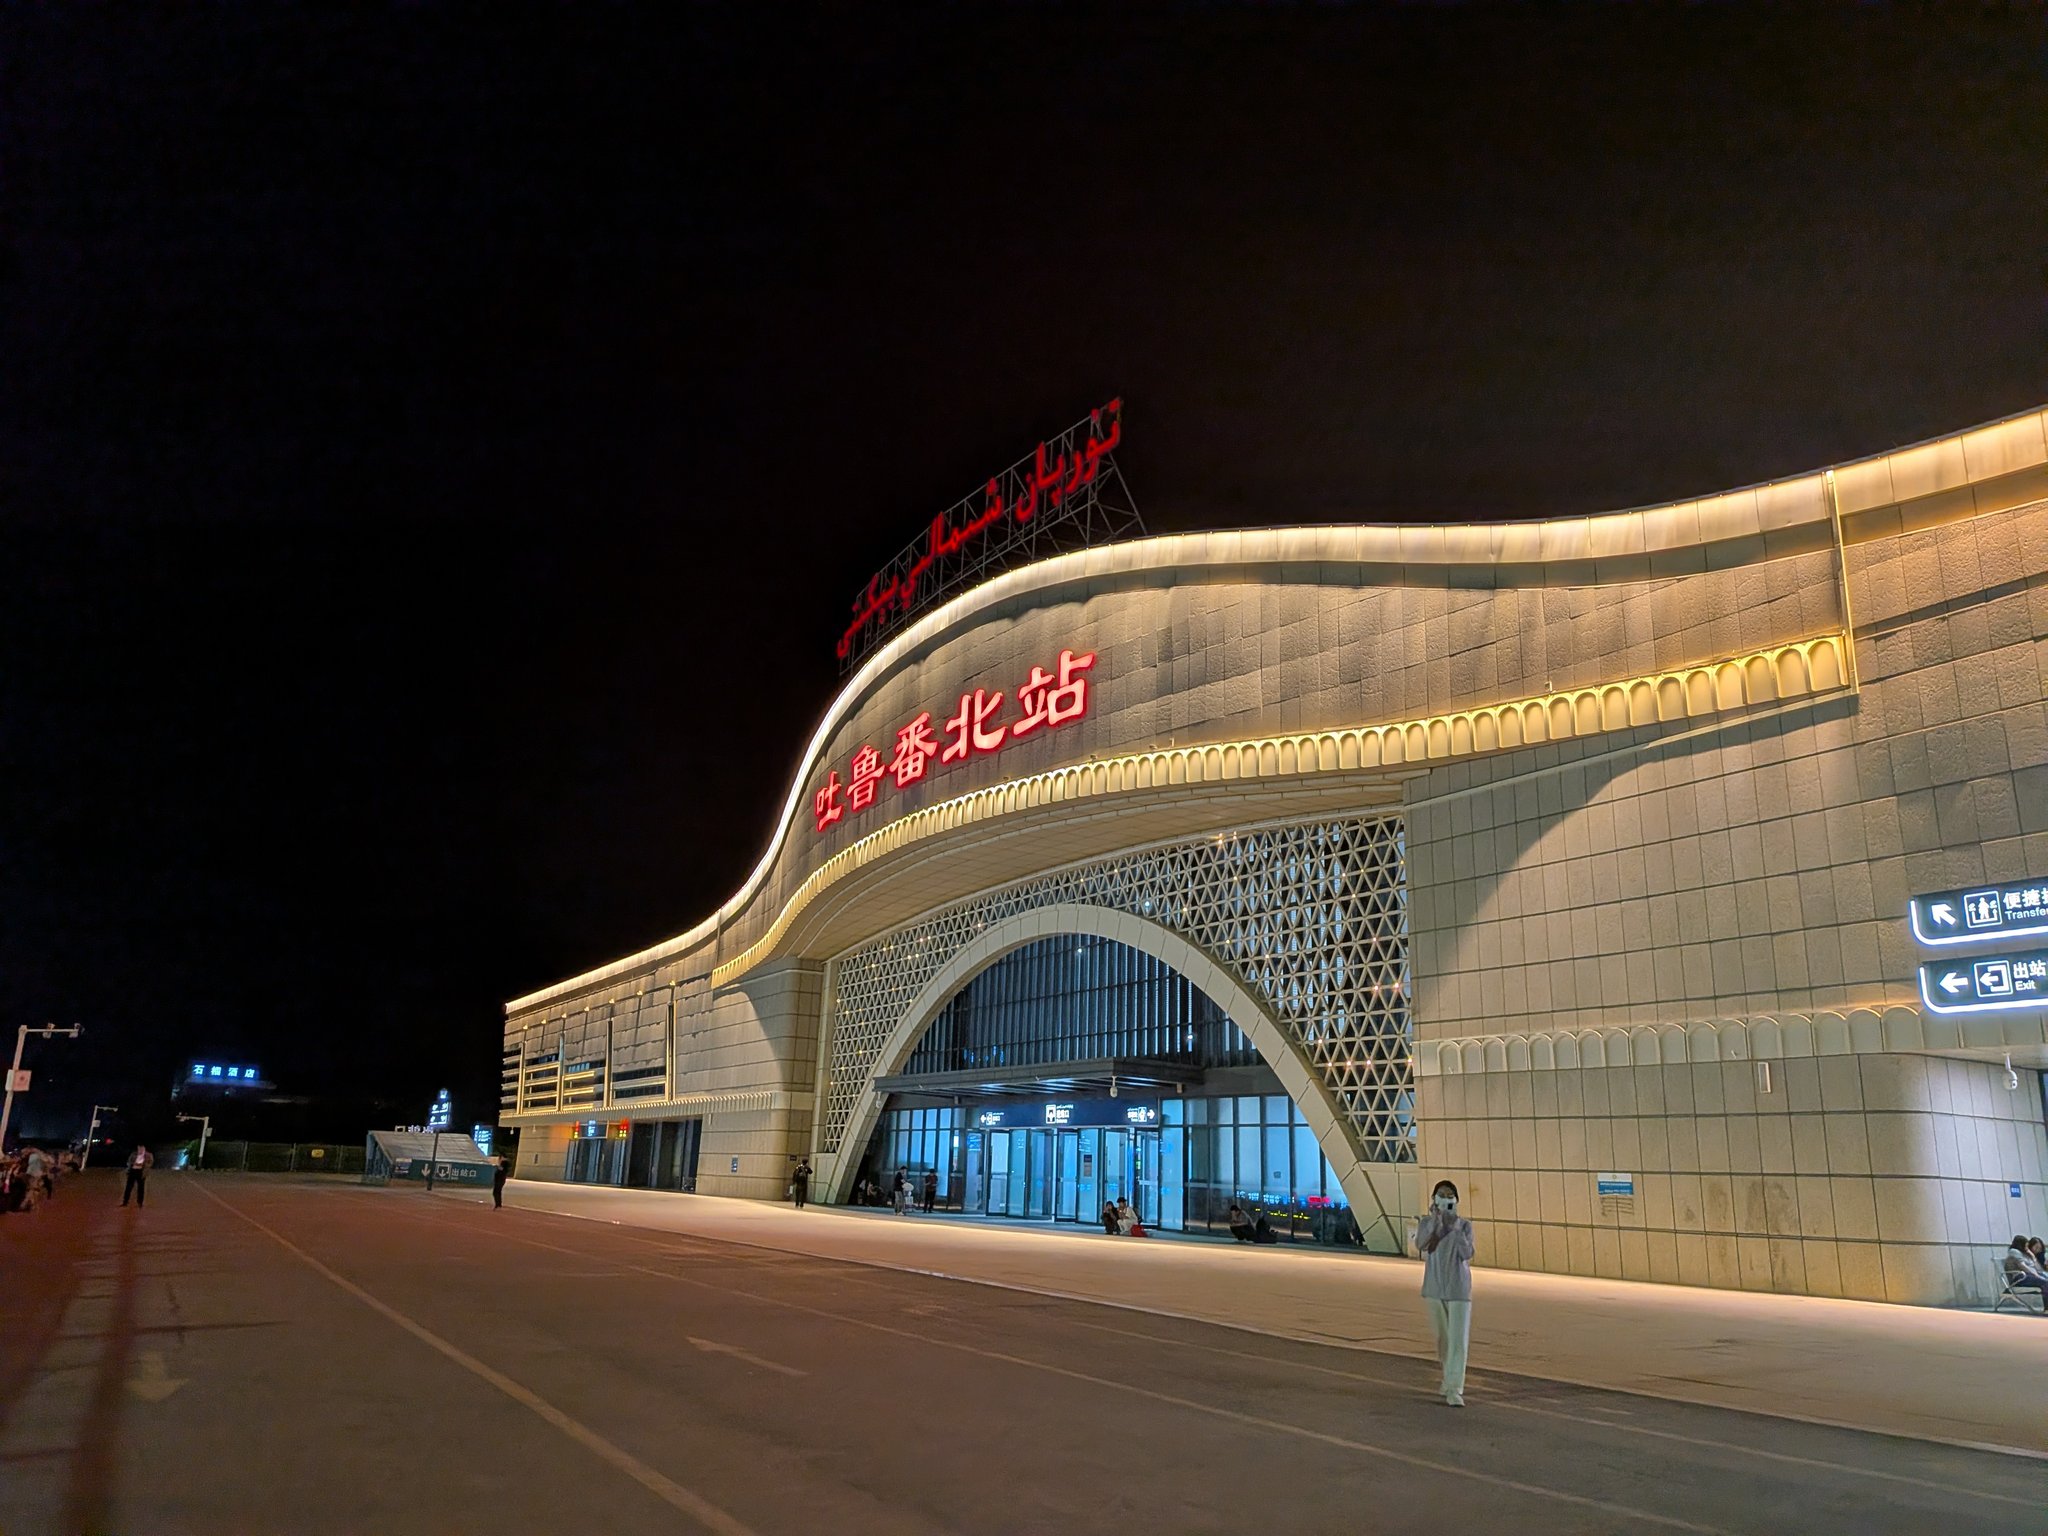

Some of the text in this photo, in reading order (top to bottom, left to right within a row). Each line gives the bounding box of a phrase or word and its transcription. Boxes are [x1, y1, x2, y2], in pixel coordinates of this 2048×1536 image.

[814, 649, 1096, 832] 吐鲁番北站
[2013, 959, 2047, 979] 出站
[2015, 980, 2036, 991] Exit
